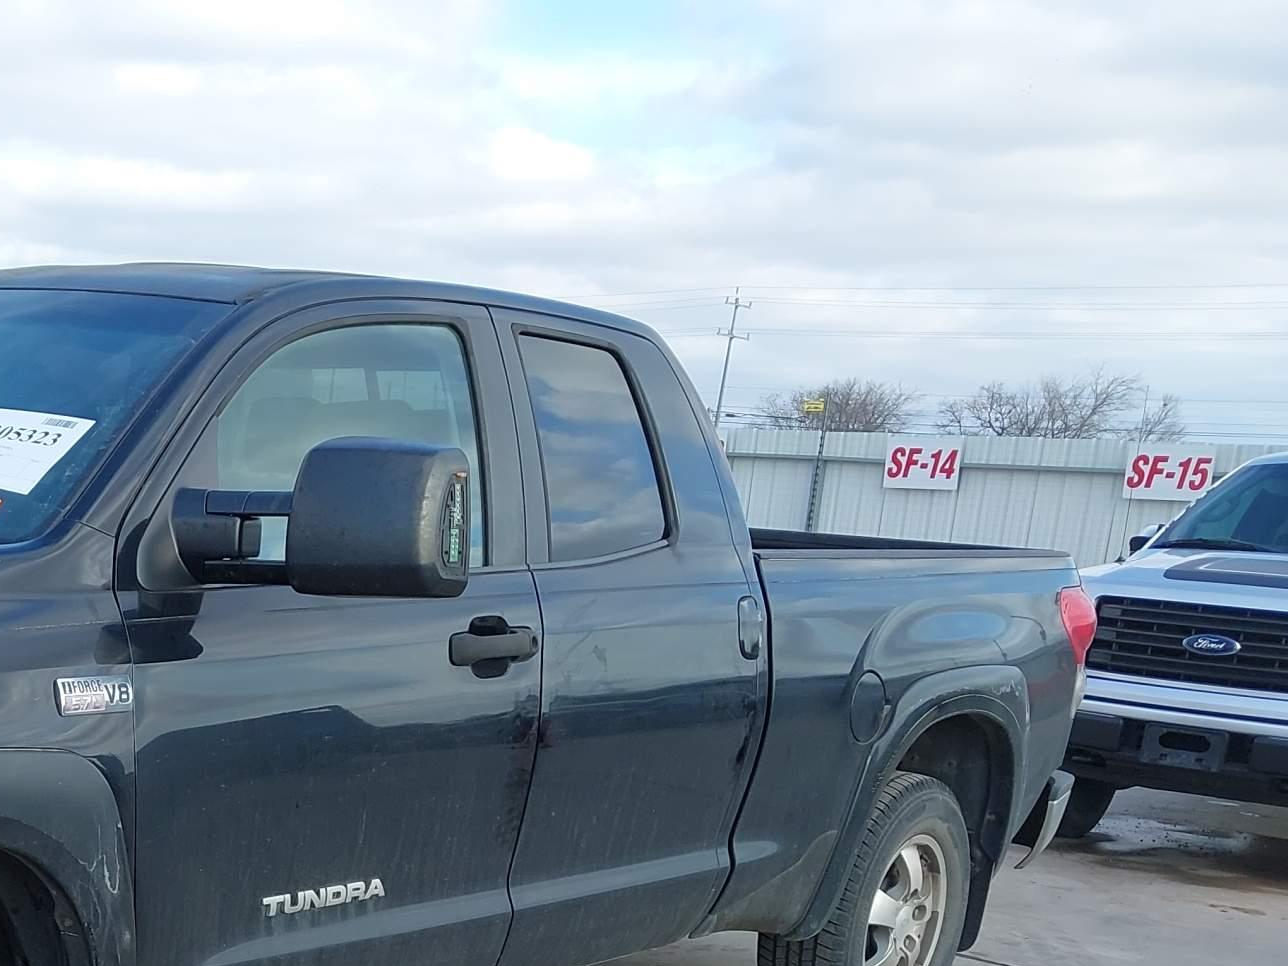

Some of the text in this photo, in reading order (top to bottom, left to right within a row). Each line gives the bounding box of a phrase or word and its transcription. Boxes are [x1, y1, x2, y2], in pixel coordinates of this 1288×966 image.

[886, 446, 960, 480] SF-14
[1125, 455, 1213, 491] SF-15
[104, 681, 130, 705] V8
[262, 878, 385, 917] TUNDRA
